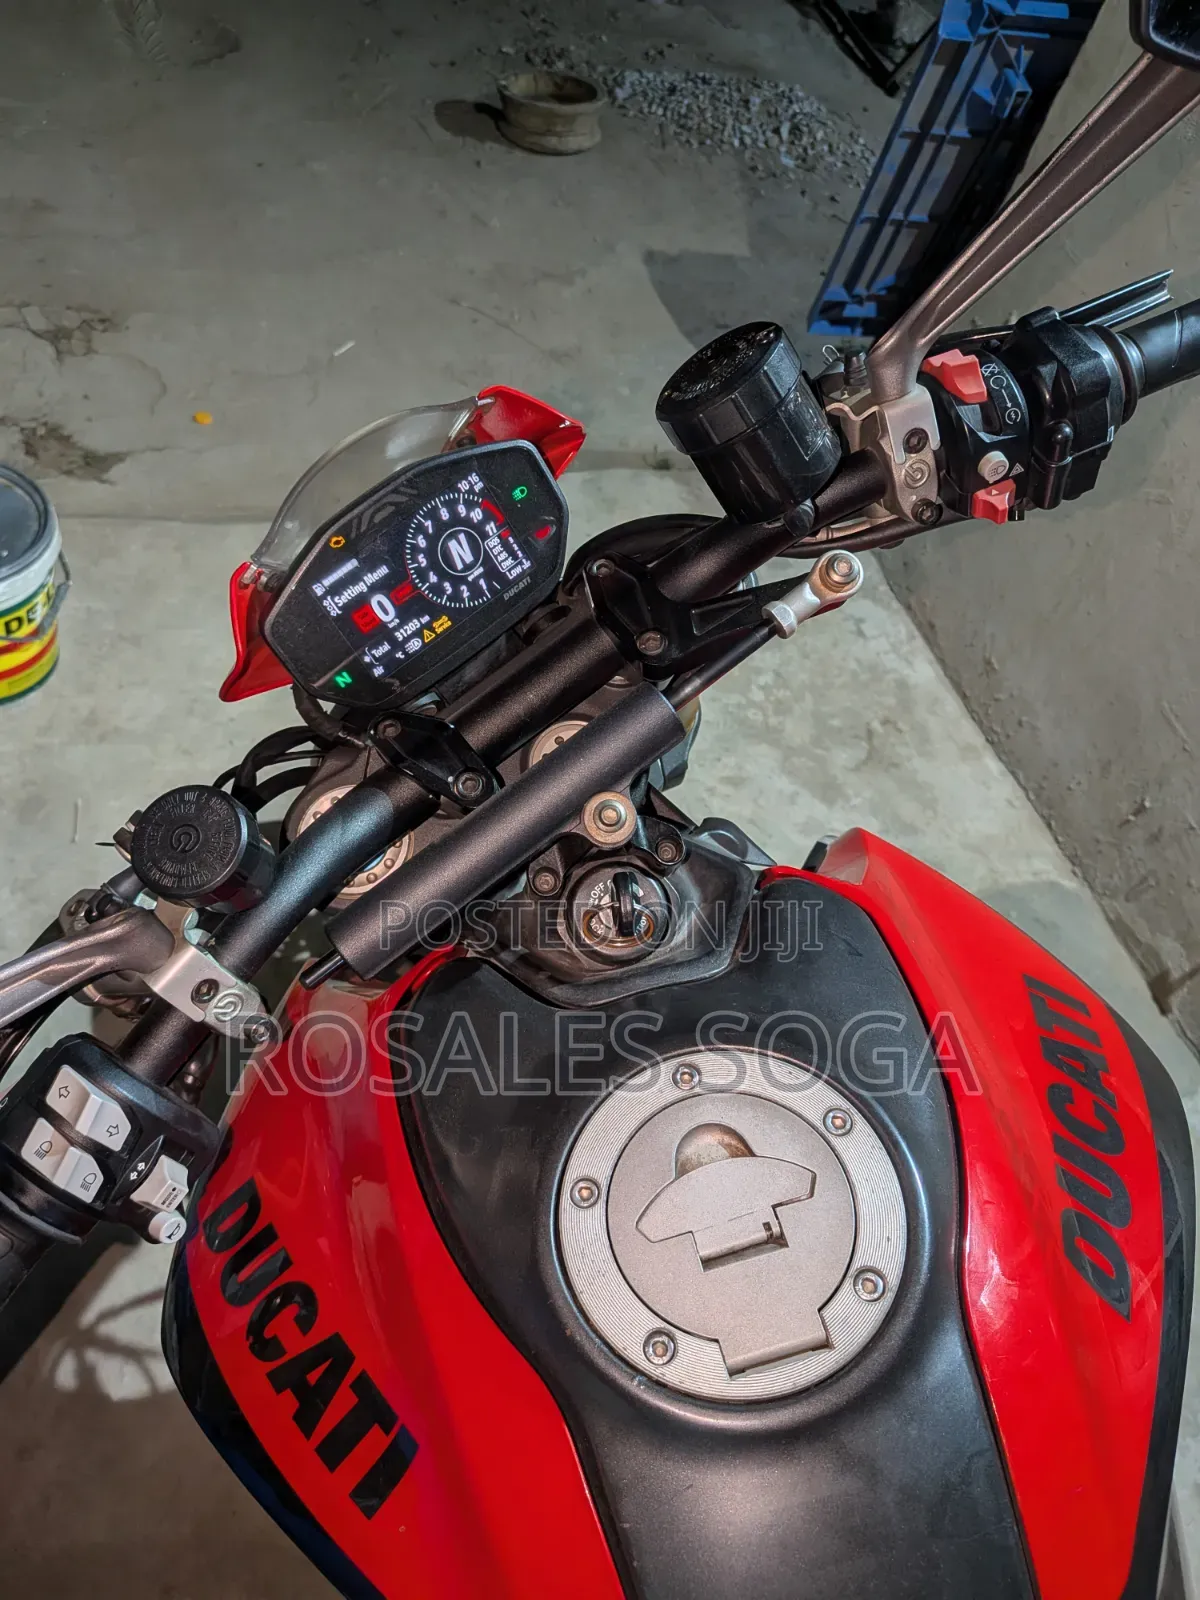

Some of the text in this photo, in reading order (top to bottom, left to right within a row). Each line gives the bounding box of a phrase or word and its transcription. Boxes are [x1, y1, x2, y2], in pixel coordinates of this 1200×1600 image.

[458, 472, 480, 493] 10:16
[439, 507, 449, 520] 8
[457, 504, 467, 517] 9
[469, 507, 483, 523] 10
[424, 520, 433, 534] 7
[485, 521, 498, 537] 11
[416, 534, 427, 548] 6
[447, 532, 474, 571] N
[417, 553, 427, 567] 5
[428, 571, 438, 583] 4
[479, 578, 487, 590] 1
[335, 580, 368, 607] Setting
[364, 565, 389, 589] Menu
[443, 581, 452, 595] 3
[460, 585, 470, 598] 2
[503, 576, 531, 601] DUCATI
[370, 594, 396, 623] 0
[394, 618, 421, 642] 31203
[371, 641, 391, 659] Total
[373, 665, 385, 678] Air
[334, 671, 353, 689] N
[590, 882, 605, 898] OFF
[1022, 973, 1133, 1324] DUCATI
[202, 1176, 420, 1521] DUCATI
